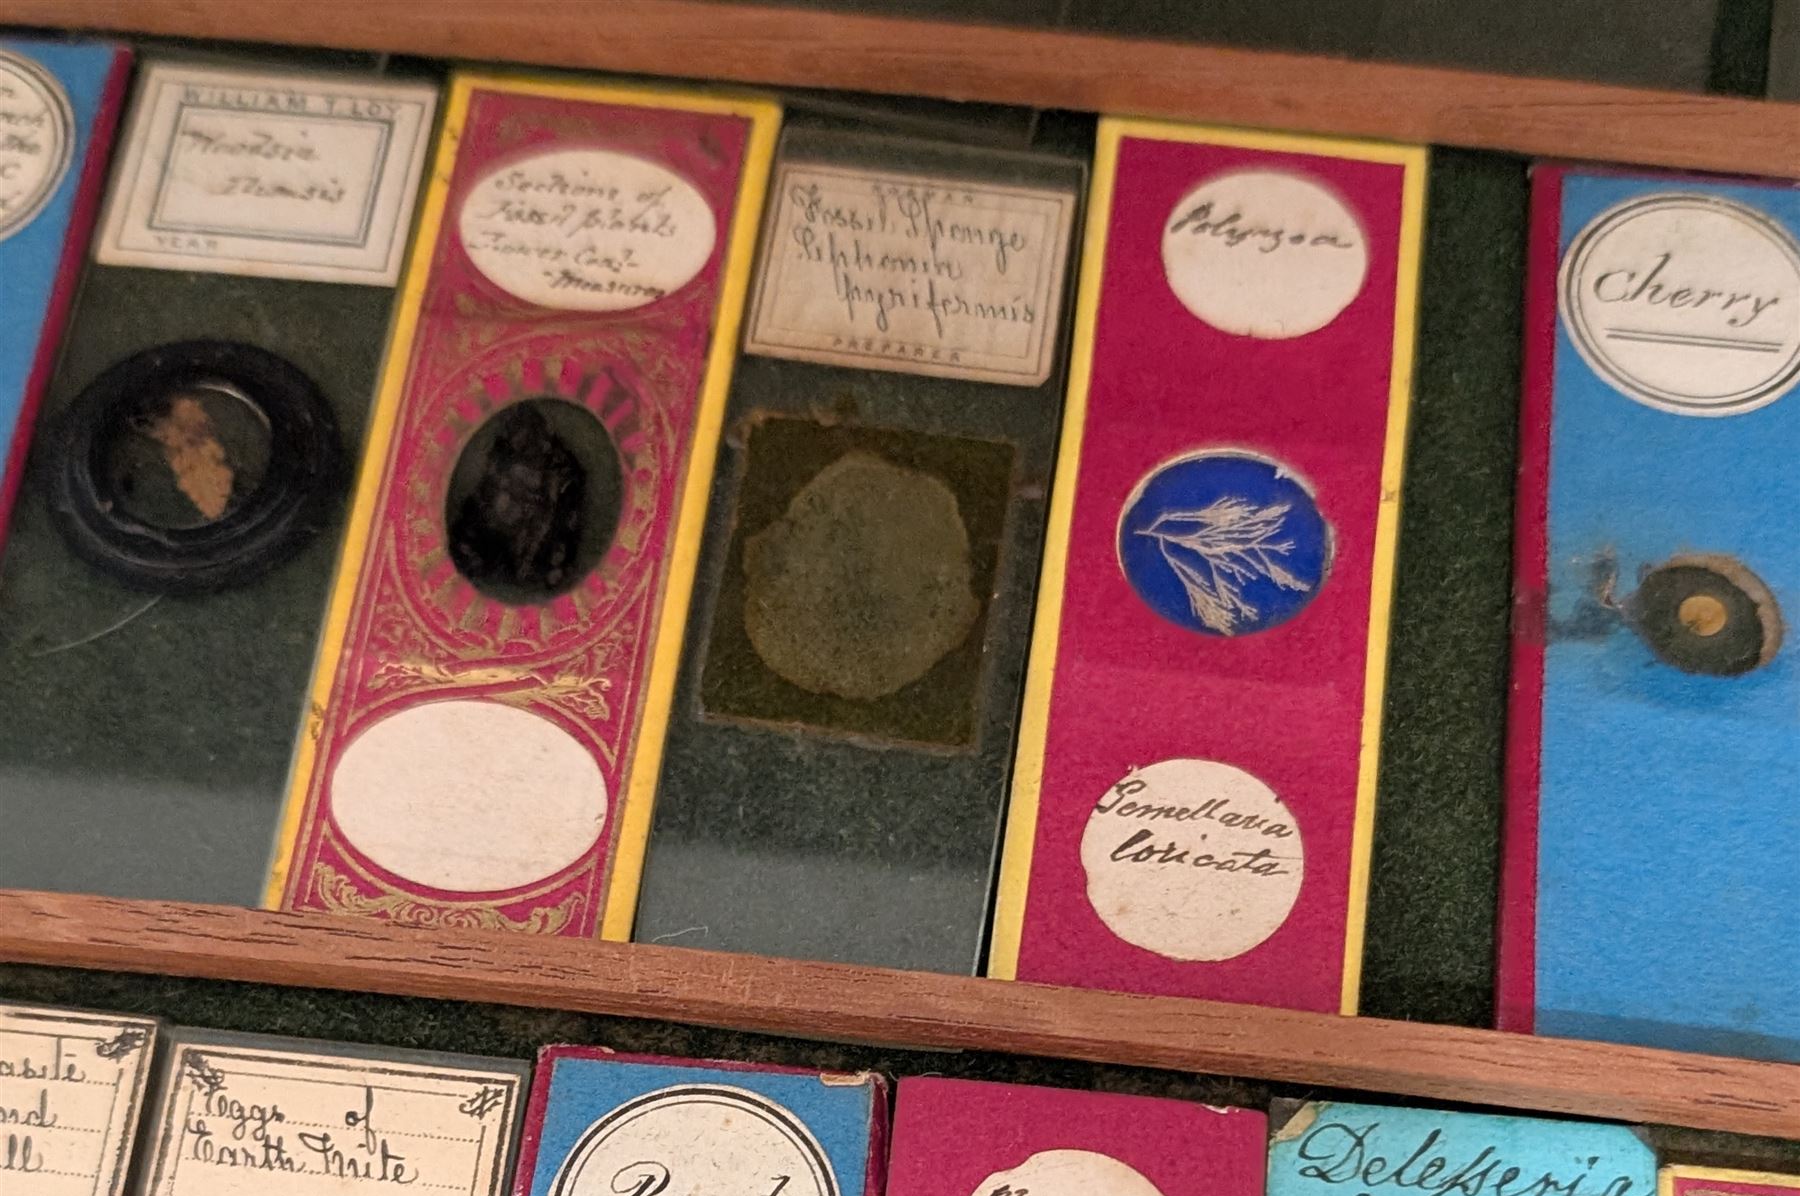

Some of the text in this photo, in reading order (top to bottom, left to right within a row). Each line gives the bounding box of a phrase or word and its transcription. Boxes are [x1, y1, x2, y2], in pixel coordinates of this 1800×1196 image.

[351, 99, 402, 119] LOY
[630, 186, 673, 226] of
[1593, 252, 1780, 328] Cherry
[345, 1086, 377, 1156] of
